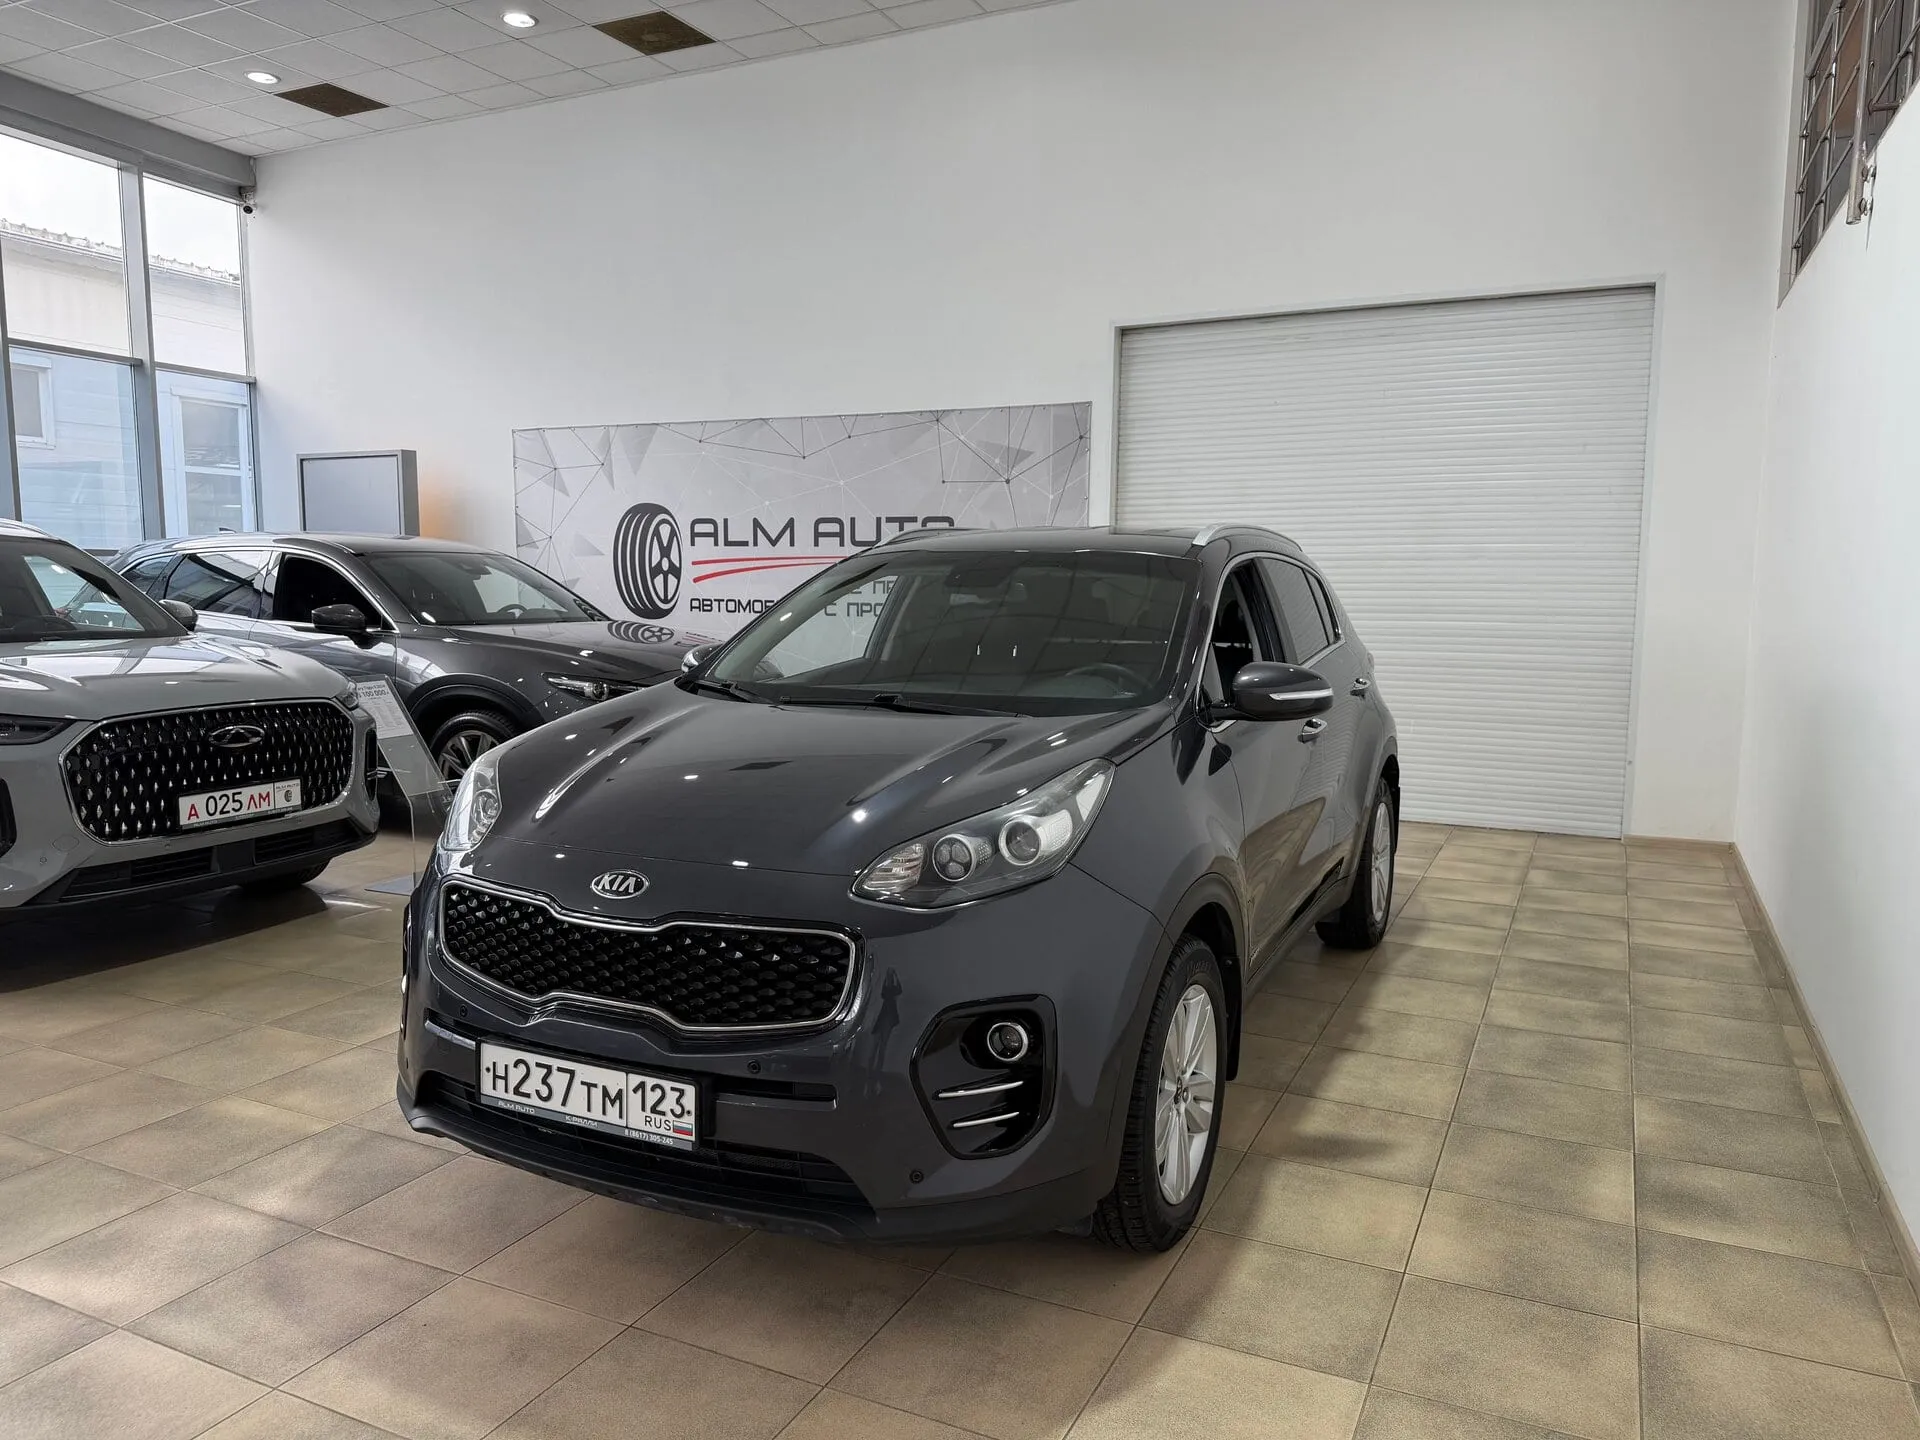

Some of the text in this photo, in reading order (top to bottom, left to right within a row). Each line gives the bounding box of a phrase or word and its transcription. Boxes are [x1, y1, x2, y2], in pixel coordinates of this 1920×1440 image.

[690, 517, 795, 547] ALM
[205, 791, 243, 817] 025
[597, 873, 636, 893] KIA
[515, 1105, 536, 1114] AUTO
[632, 1080, 686, 1119] 123
[644, 1115, 672, 1131] RUS
